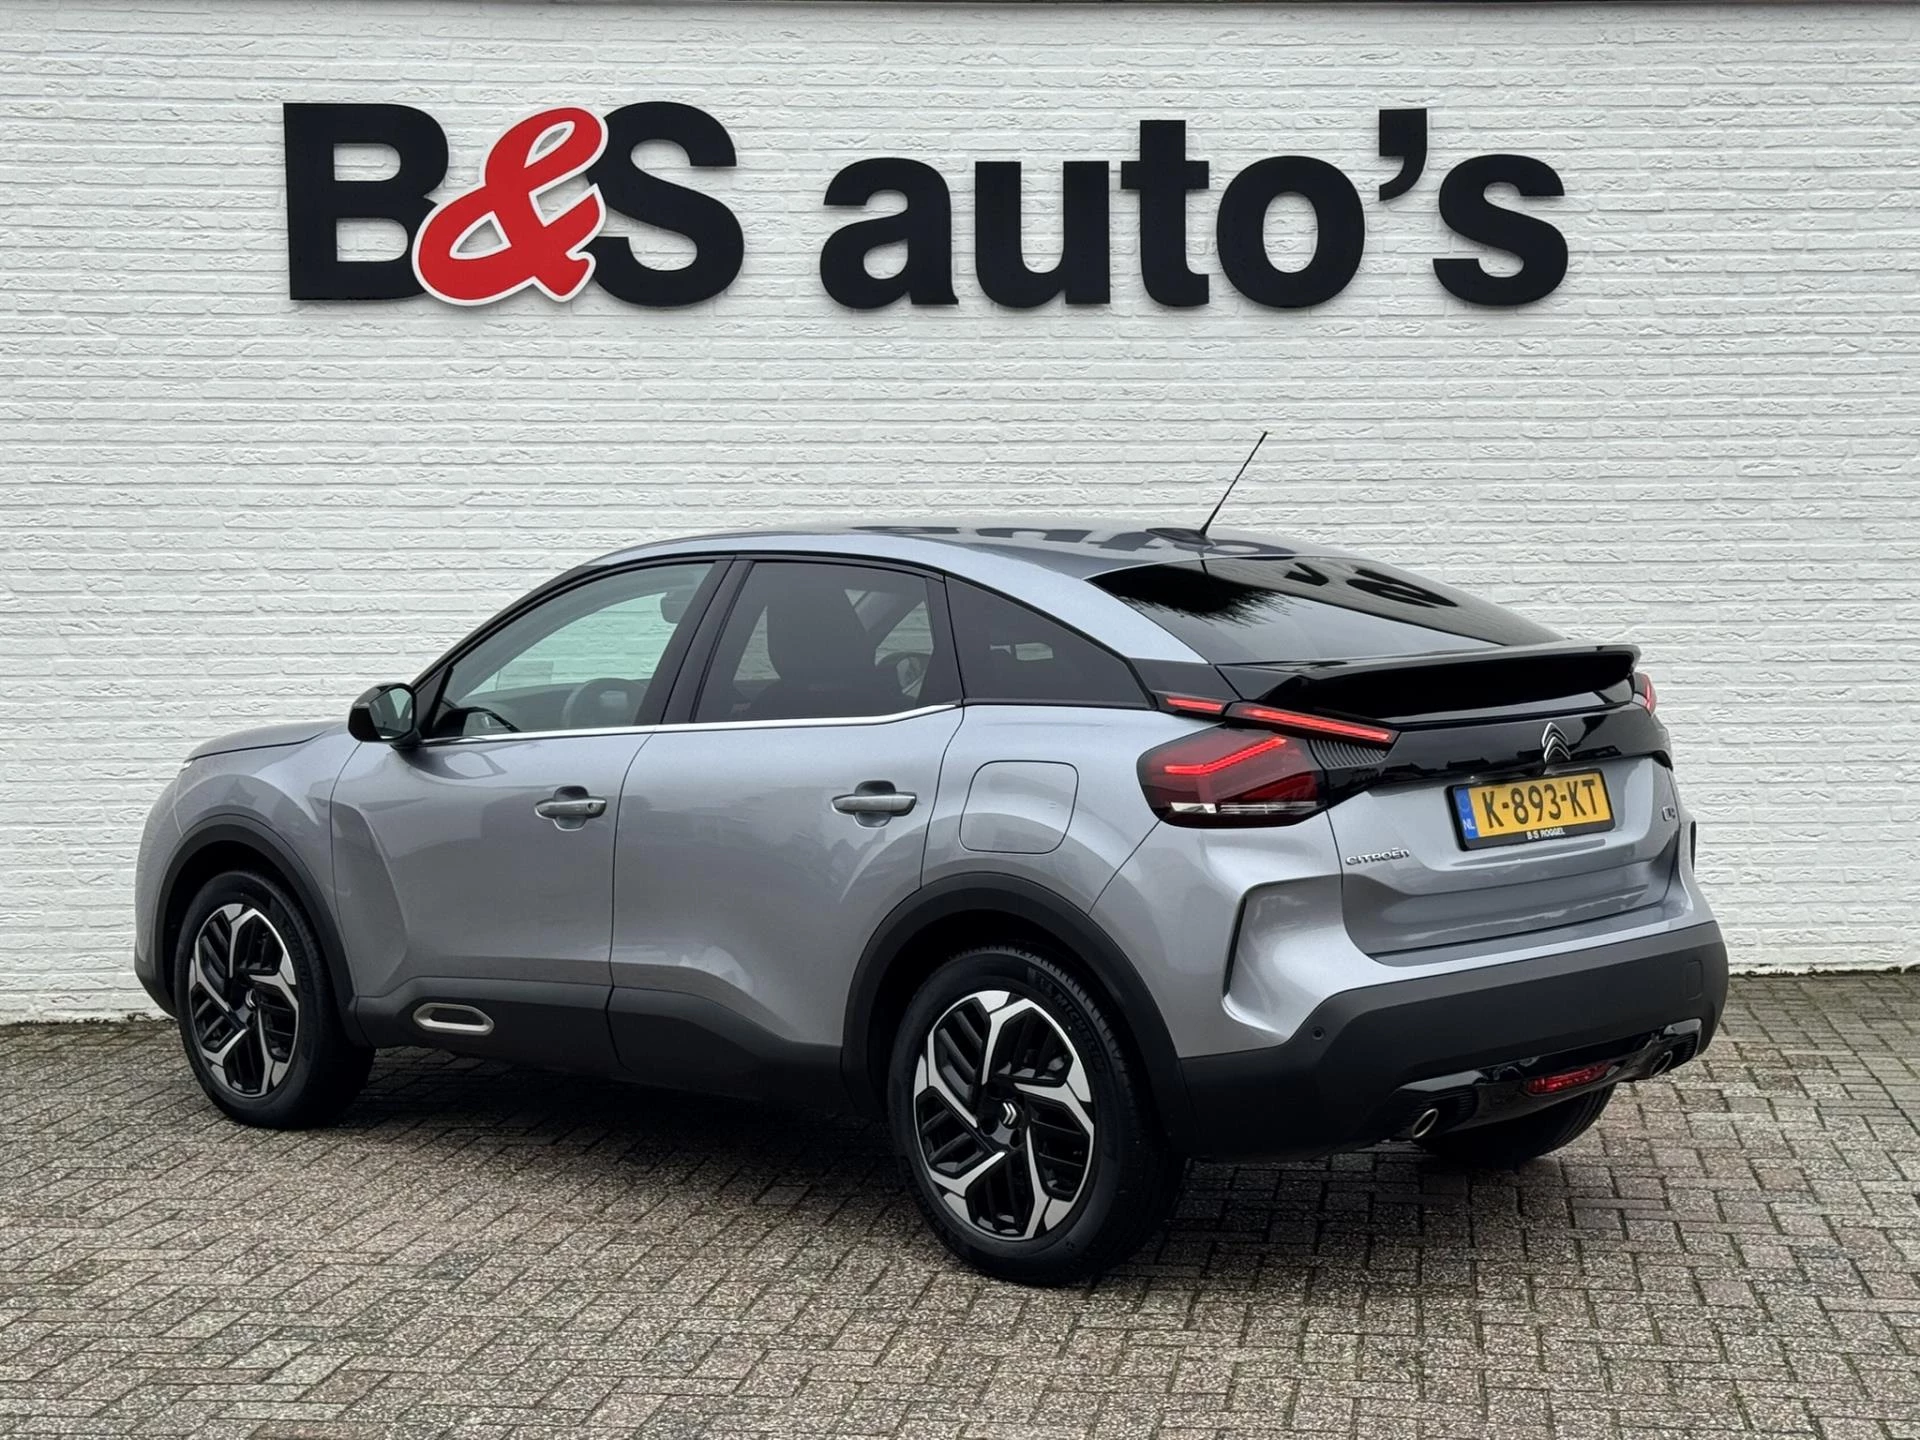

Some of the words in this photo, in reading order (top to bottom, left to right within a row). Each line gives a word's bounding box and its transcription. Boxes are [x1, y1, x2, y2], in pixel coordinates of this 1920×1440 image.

[283, 101, 745, 309] B&S
[819, 108, 1568, 311] auto's
[1463, 819, 1476, 830] NL
[1482, 779, 1597, 829] K-893-KT
